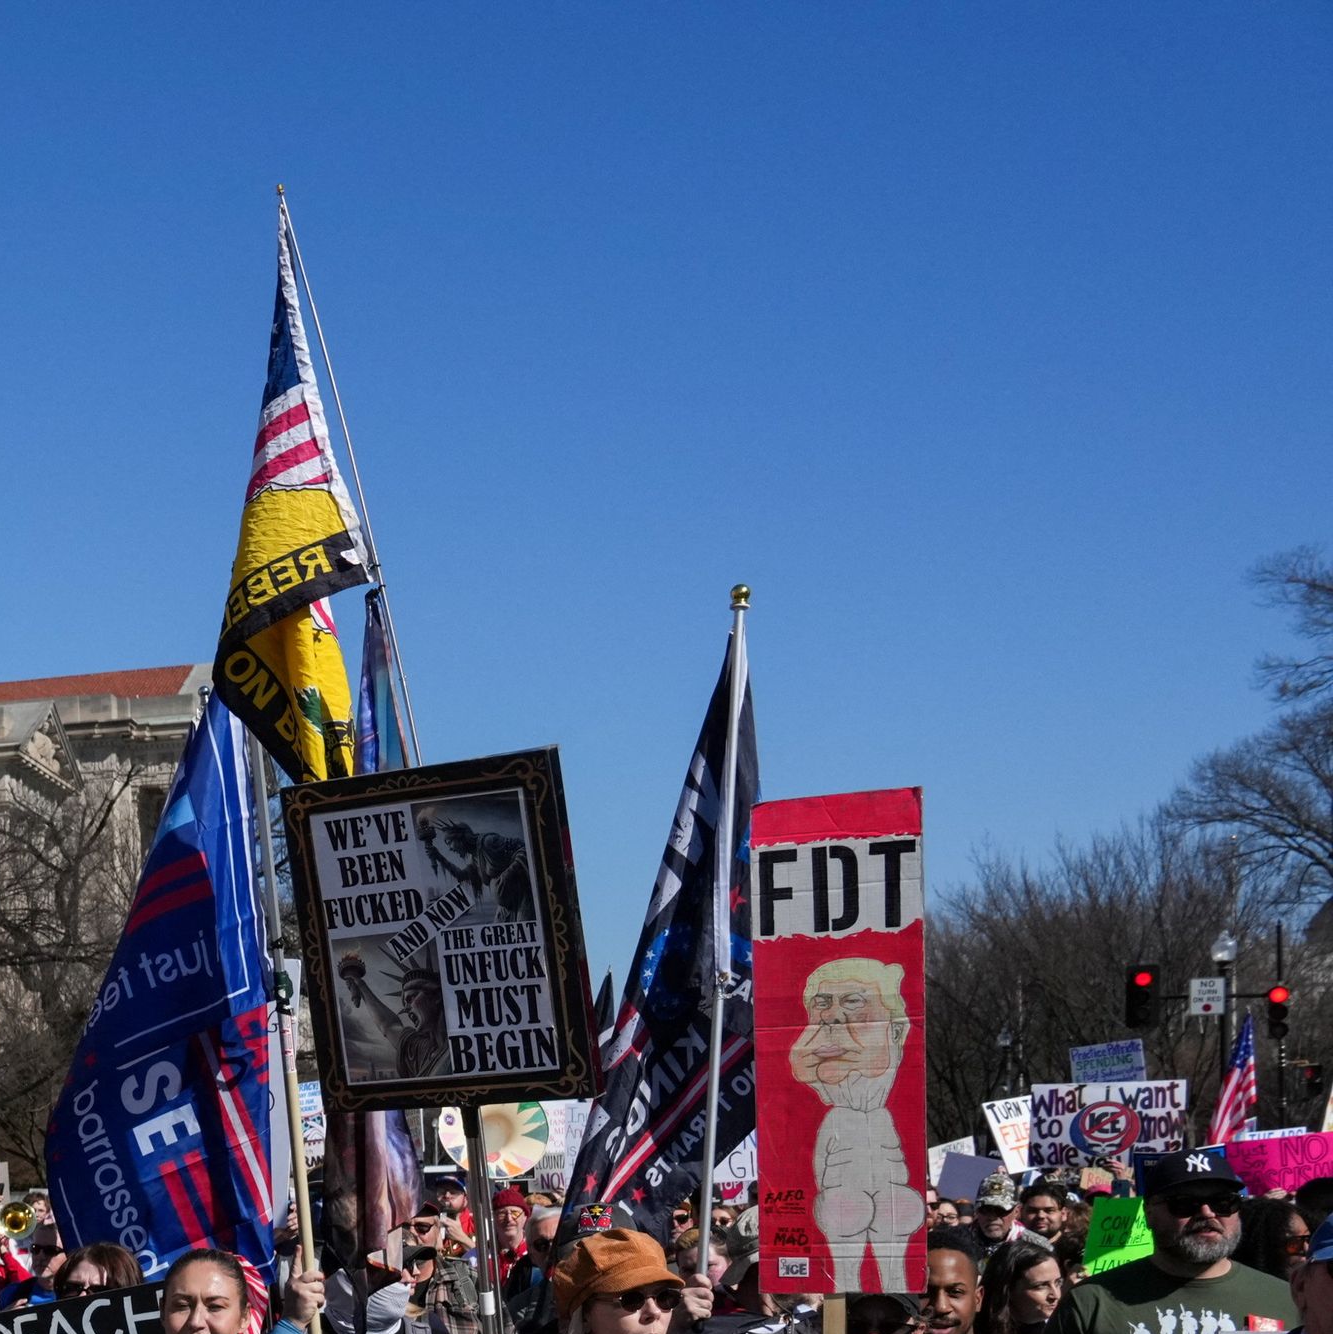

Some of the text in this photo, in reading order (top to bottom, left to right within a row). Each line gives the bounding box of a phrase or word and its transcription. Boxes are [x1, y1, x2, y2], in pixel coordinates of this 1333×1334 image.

[324, 811, 408, 851] WE'VE
[337, 850, 407, 888] BEEN
[759, 839, 916, 936] FDT
[325, 889, 424, 930] FUCKED
[389, 885, 472, 961] AND NOW
[441, 922, 537, 951] THE GREAT
[443, 946, 546, 986] UNFUCK
[1200, 980, 1216, 988] NO
[454, 985, 541, 1029] MUST
[449, 1027, 556, 1074] BEGIN
[1076, 1053, 1133, 1071] SPENDING
[986, 1101, 1022, 1125] TURN
[1033, 1084, 1087, 1117] What
[1118, 1081, 1182, 1110] want
[1033, 1115, 1063, 1140] to
[1088, 1111, 1121, 1134] ICE
[1047, 1142, 1079, 1168] are
[1280, 1136, 1328, 1167] NO
[719, 1180, 740, 1190] TOP
[773, 1232, 809, 1246] MAD
[784, 1263, 808, 1276] ICE
